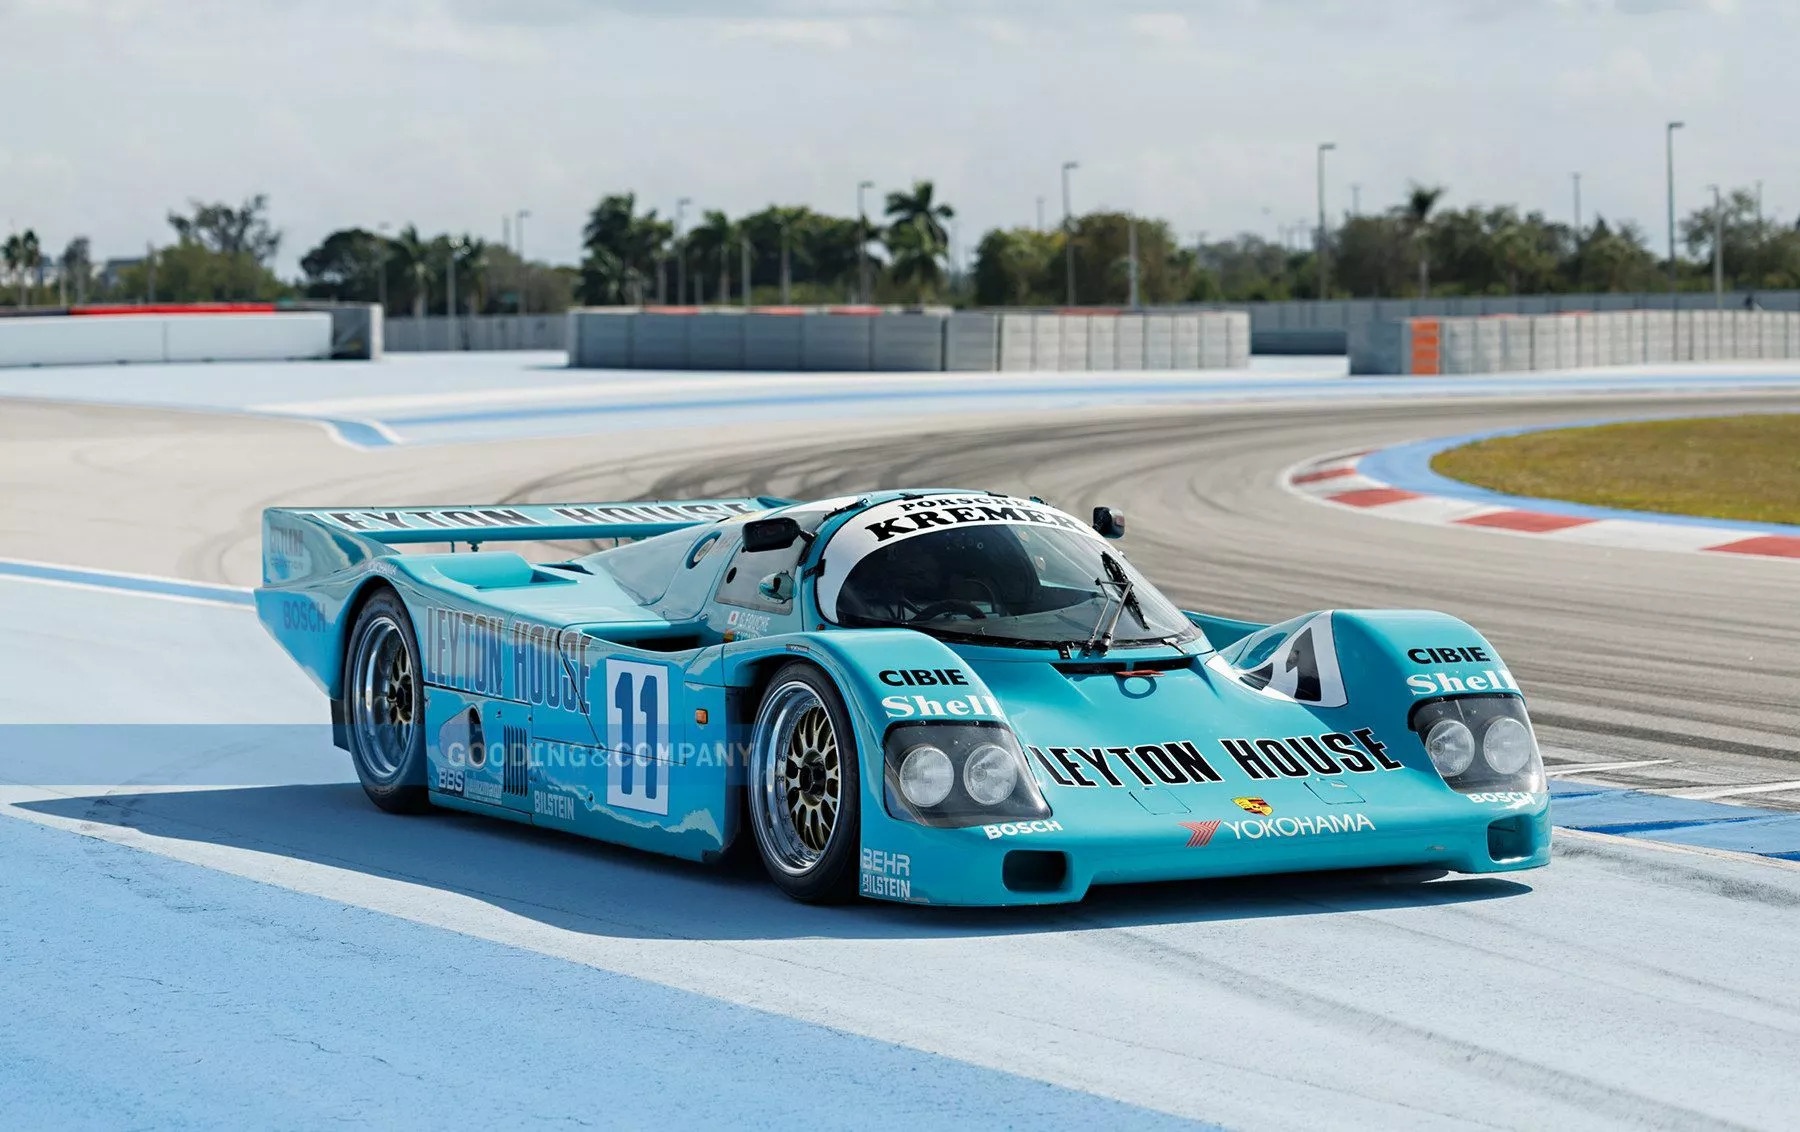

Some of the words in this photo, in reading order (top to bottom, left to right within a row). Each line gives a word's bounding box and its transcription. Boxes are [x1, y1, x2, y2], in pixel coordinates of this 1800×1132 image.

[899, 496, 1031, 512] PORSCHE
[298, 508, 542, 532] EYTON
[864, 505, 1089, 542] KREMER
[284, 601, 326, 632] BOSCH
[425, 605, 504, 699] LEYTON
[512, 619, 592, 716] HOUSE
[1408, 646, 1491, 665] CIBIE
[878, 668, 969, 687] CIBIE
[1406, 670, 1522, 696] Shell
[881, 695, 1005, 718] Shell
[614, 672, 659, 800] 11
[1024, 739, 1226, 789] LEYTON
[1220, 726, 1406, 781] HOUSE
[438, 768, 464, 792] BBS
[533, 790, 575, 820] BILSTEIN
[1465, 791, 1536, 806] BOSCH
[982, 820, 1064, 840] BOSCH
[1225, 812, 1376, 840] YOKOHAMA
[862, 847, 911, 877] BEHR
[862, 873, 911, 898] BILSTEIN
